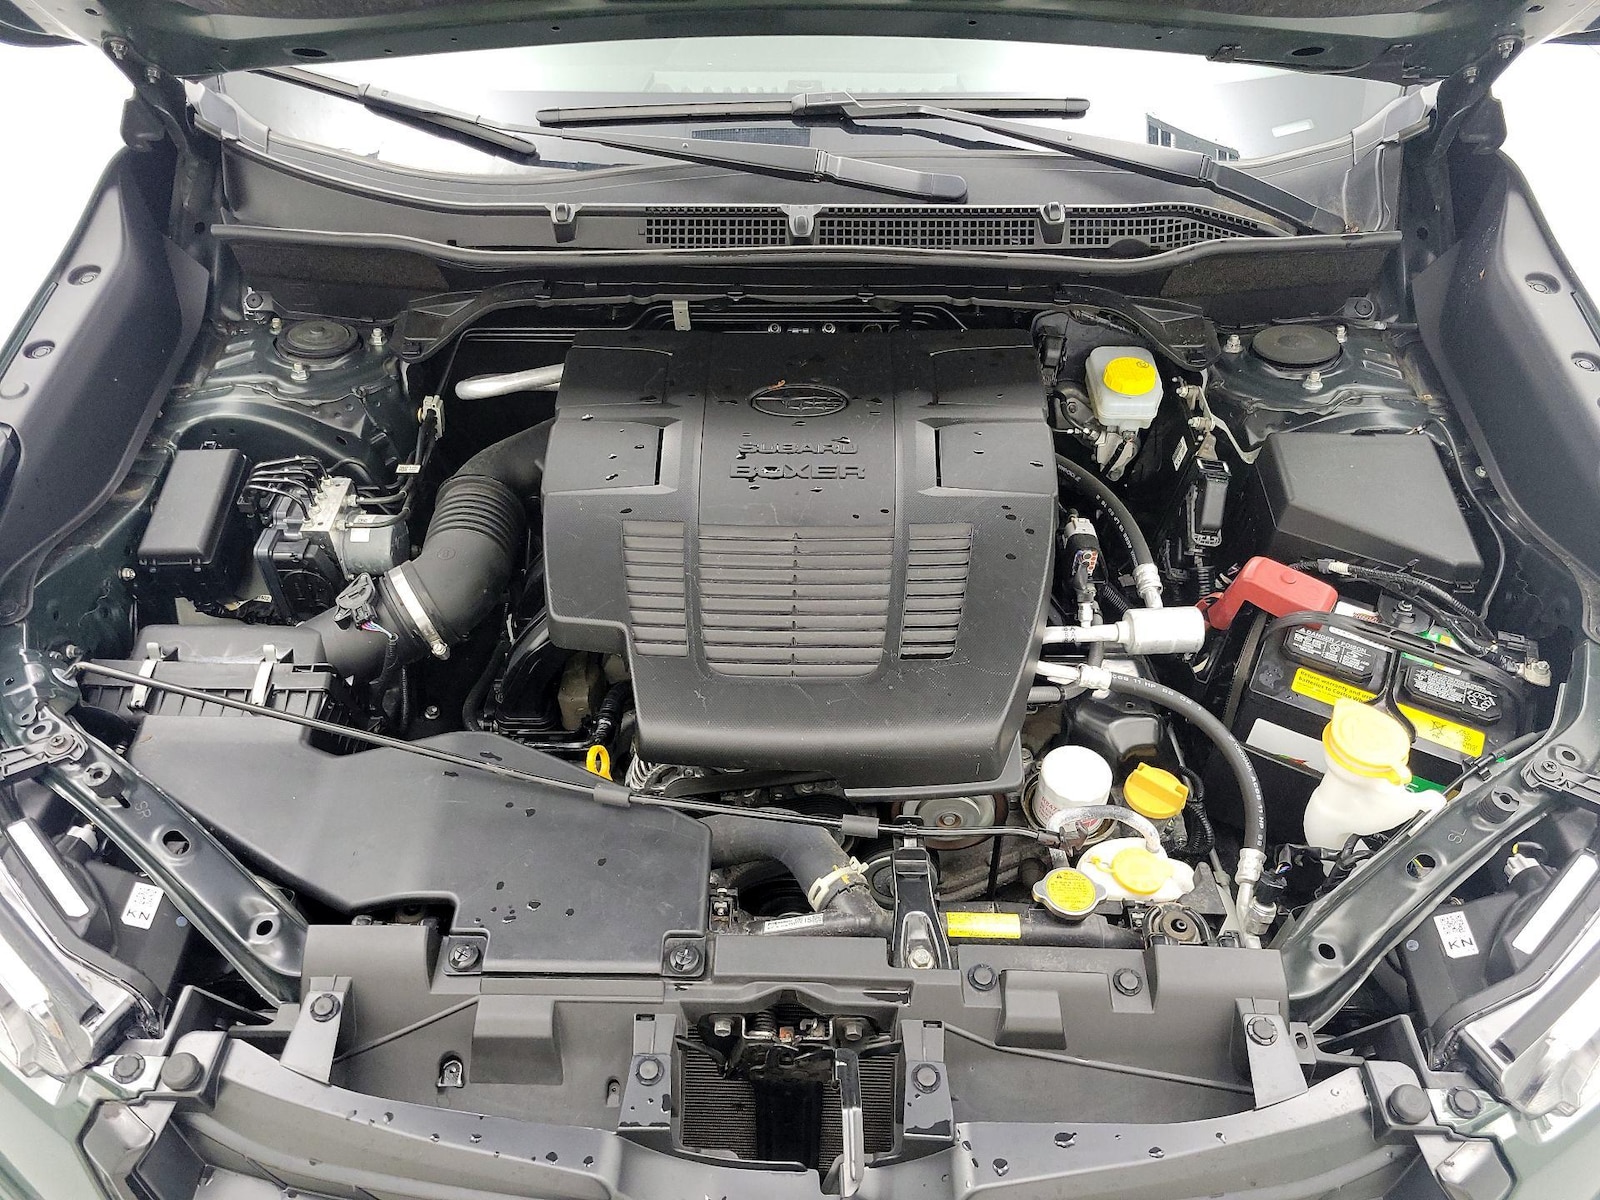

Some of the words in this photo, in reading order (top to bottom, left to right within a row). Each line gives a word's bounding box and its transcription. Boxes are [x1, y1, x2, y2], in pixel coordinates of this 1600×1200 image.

[738, 442, 859, 455] SUBARU
[730, 463, 865, 479] BOXER
[1306, 629, 1335, 643] DANGER
[1340, 641, 1367, 655] POISON
[1300, 670, 1320, 681] Return
[1321, 679, 1348, 692] warranty
[1349, 688, 1361, 696] and
[1332, 688, 1352, 699] Costco
[1234, 742, 1252, 773] YOKOHAMA
[1258, 816, 1265, 829] HP
[134, 800, 152, 820] SR
[1447, 828, 1468, 844] SL
[1448, 937, 1474, 950] KN
